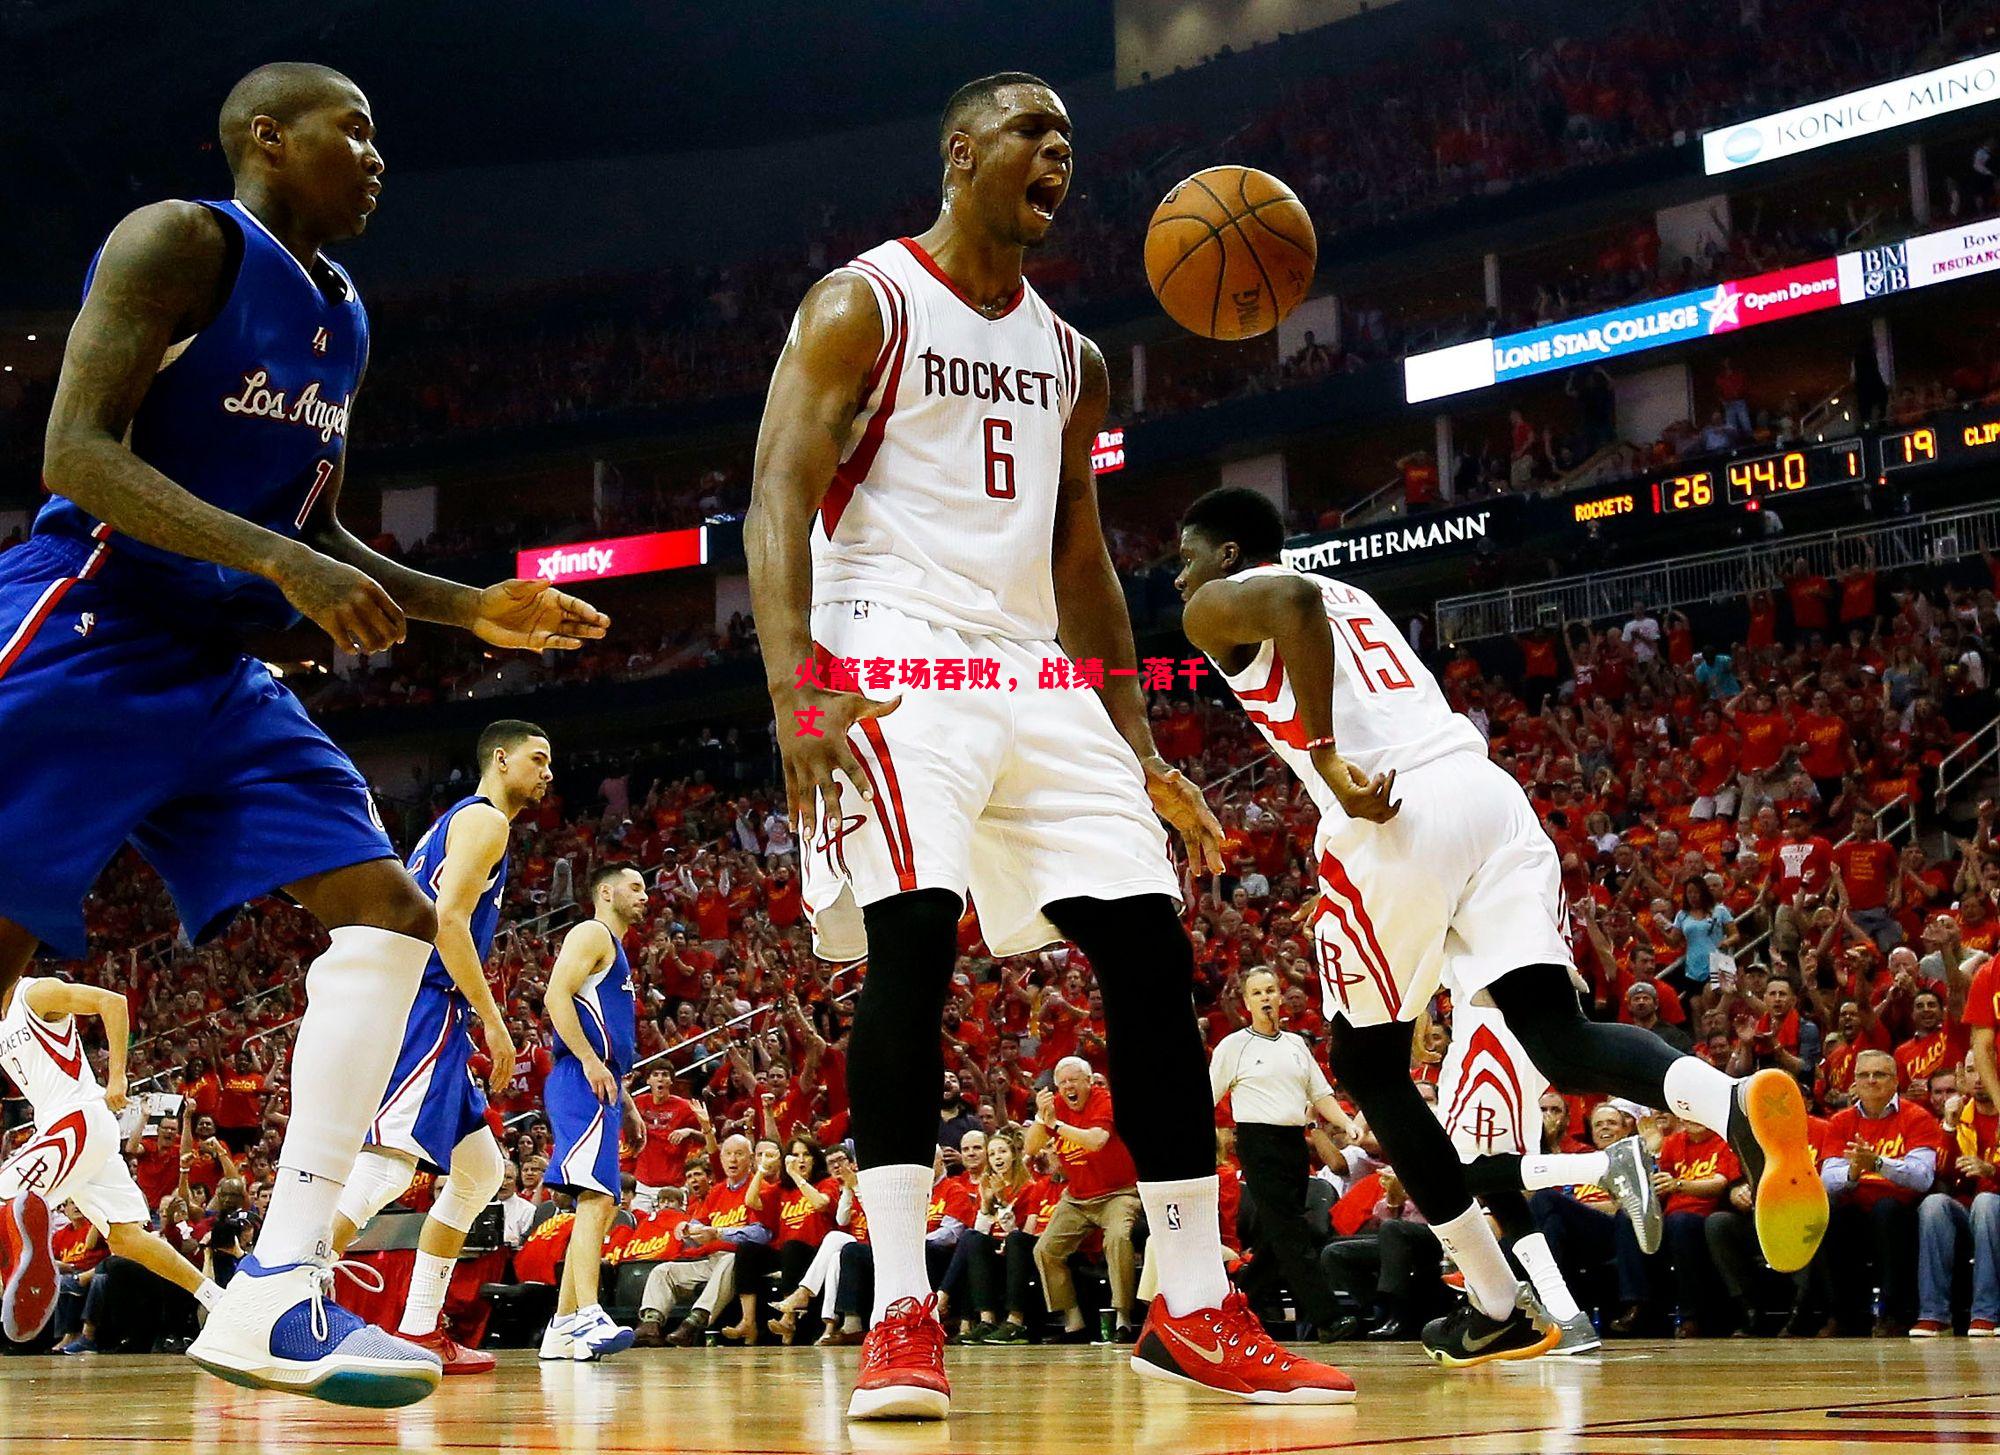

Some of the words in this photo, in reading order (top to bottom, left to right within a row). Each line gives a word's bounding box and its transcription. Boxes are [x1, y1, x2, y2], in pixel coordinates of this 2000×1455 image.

[1777, 99, 1895, 145] KONICA
[1907, 68, 1996, 111] MINO
[1495, 338, 1551, 372] LONE
[1553, 328, 1610, 359] STAR
[1602, 306, 1699, 345] COLLEGE
[1744, 288, 1789, 311] Open
[1789, 277, 1837, 300] Doors
[223, 370, 286, 420] Los
[983, 417, 1016, 500] 6
[1848, 452, 1856, 477] 1
[1904, 429, 1934, 463] 19
[294, 459, 334, 530] 1
[1673, 474, 1711, 509] 26
[1730, 452, 1806, 496] 44.0
[1575, 495, 1633, 522] ROCKETS
[1349, 512, 1487, 563] HERMANN
[537, 547, 613, 580] xfinity
[1328, 617, 1415, 694] 15
